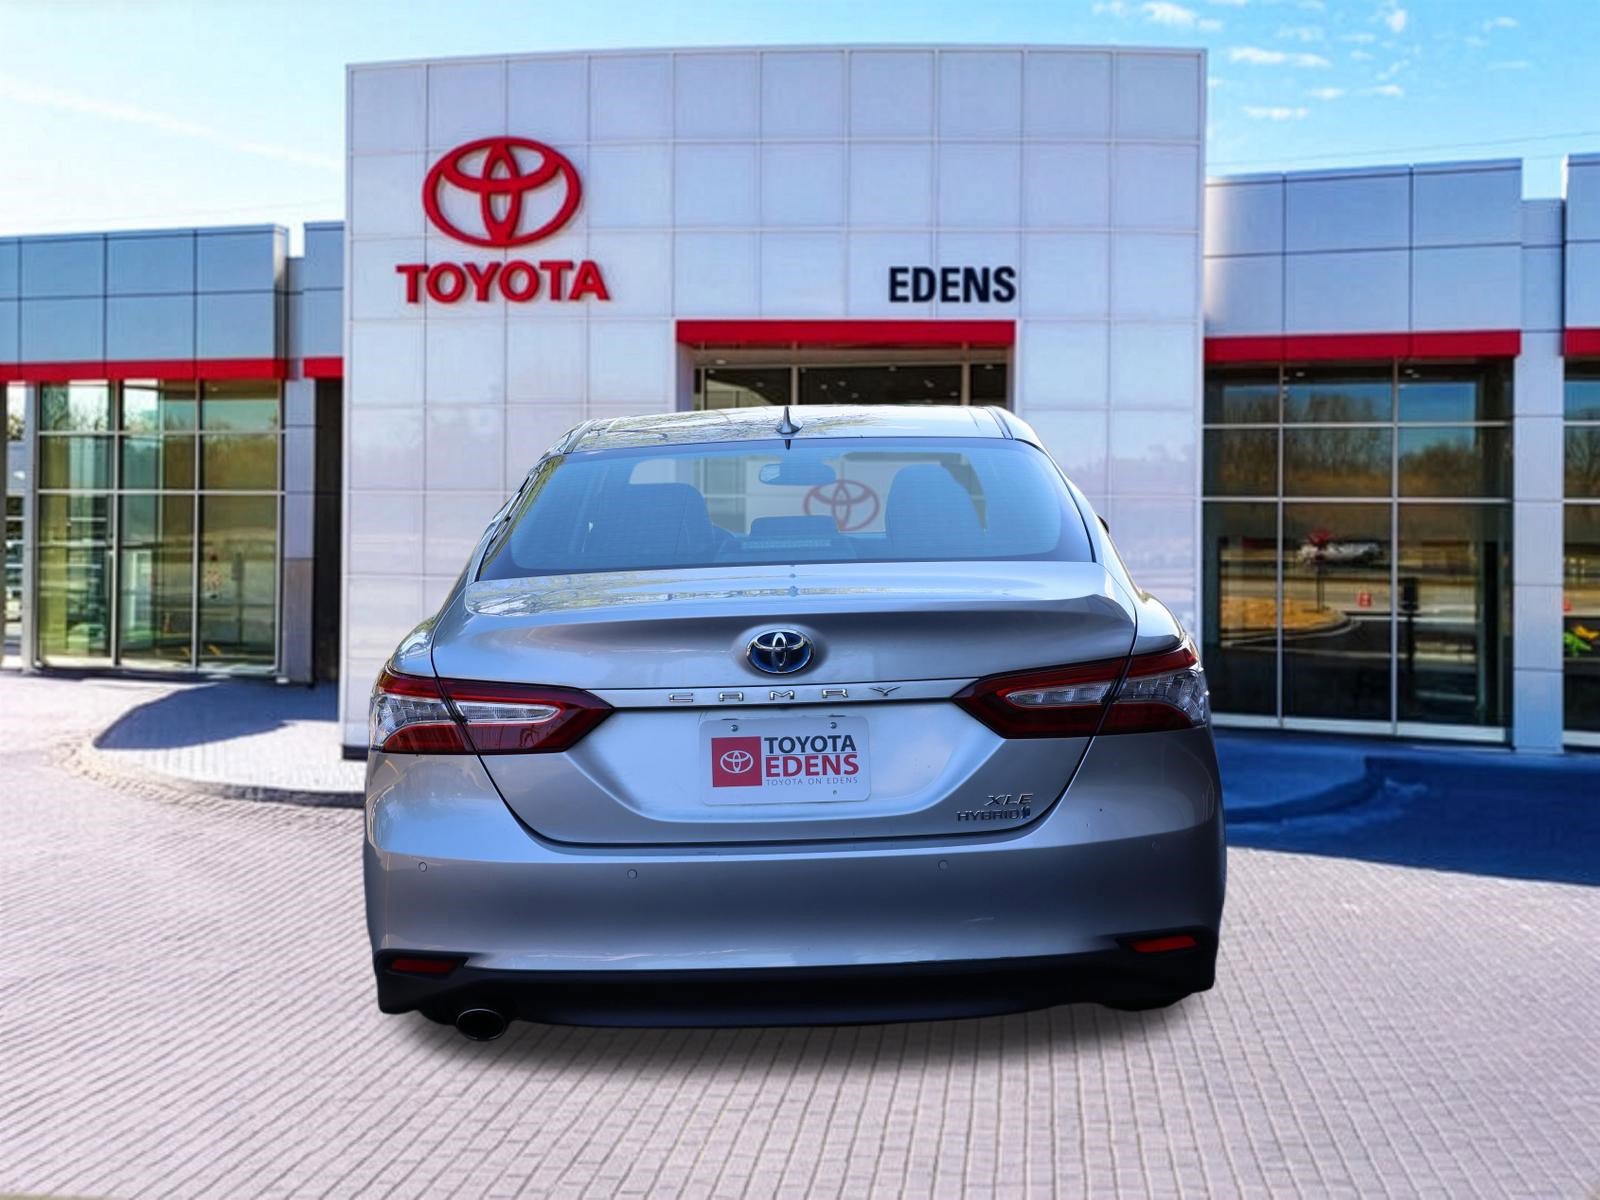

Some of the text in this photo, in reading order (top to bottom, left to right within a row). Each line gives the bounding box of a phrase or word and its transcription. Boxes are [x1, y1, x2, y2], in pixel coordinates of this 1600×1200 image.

[397, 260, 610, 303] TOYOTA
[889, 266, 1017, 303] EDENS
[668, 685, 902, 703] CAMRY
[764, 735, 857, 754] TOYOTA
[766, 754, 859, 777] EDENS
[766, 777, 859, 787] TOYOTA ON EDENS
[984, 793, 1034, 807] XLE
[956, 810, 1020, 822] HYBRID
